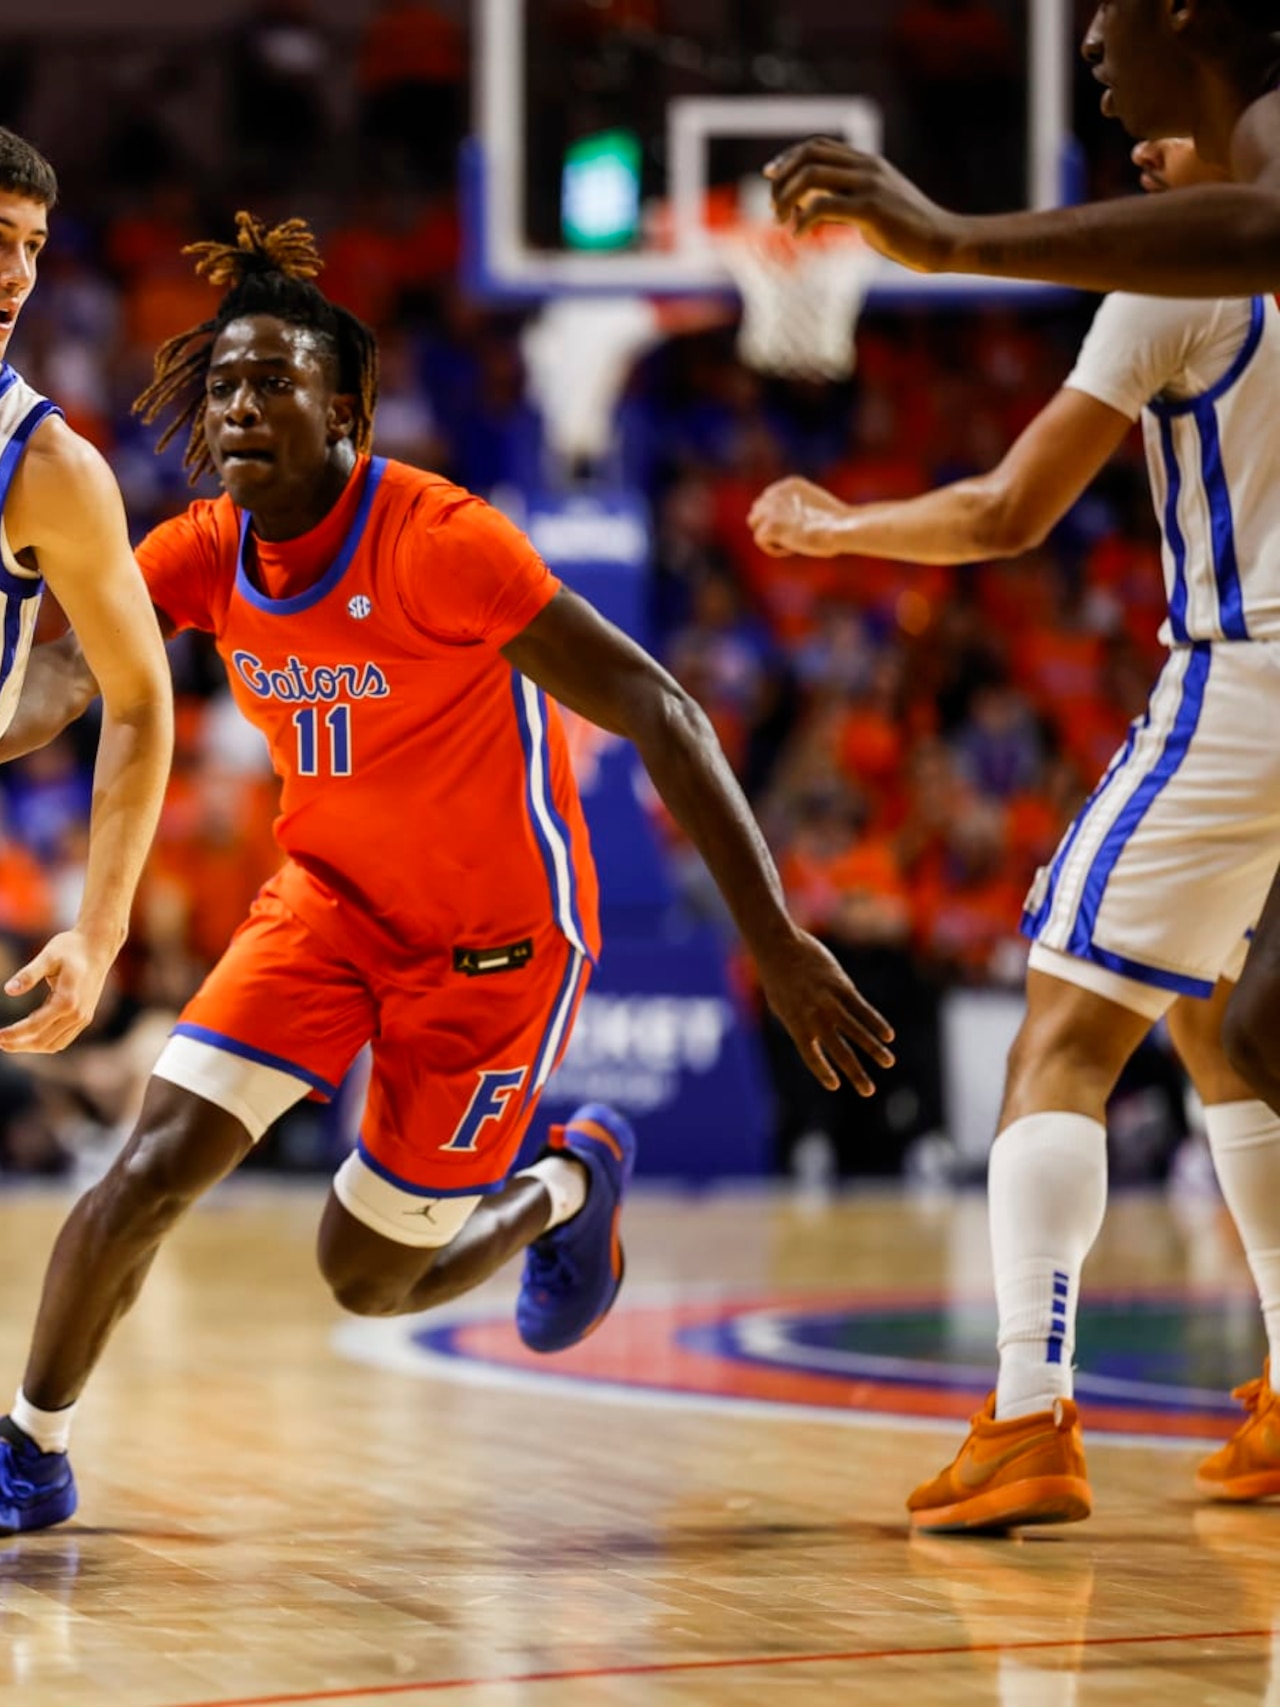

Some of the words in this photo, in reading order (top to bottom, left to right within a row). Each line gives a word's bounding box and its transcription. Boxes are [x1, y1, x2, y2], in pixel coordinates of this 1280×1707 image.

[347, 595, 372, 619] SEC
[231, 649, 391, 704] Gators
[292, 702, 353, 777] 11
[438, 1065, 529, 1152] F
